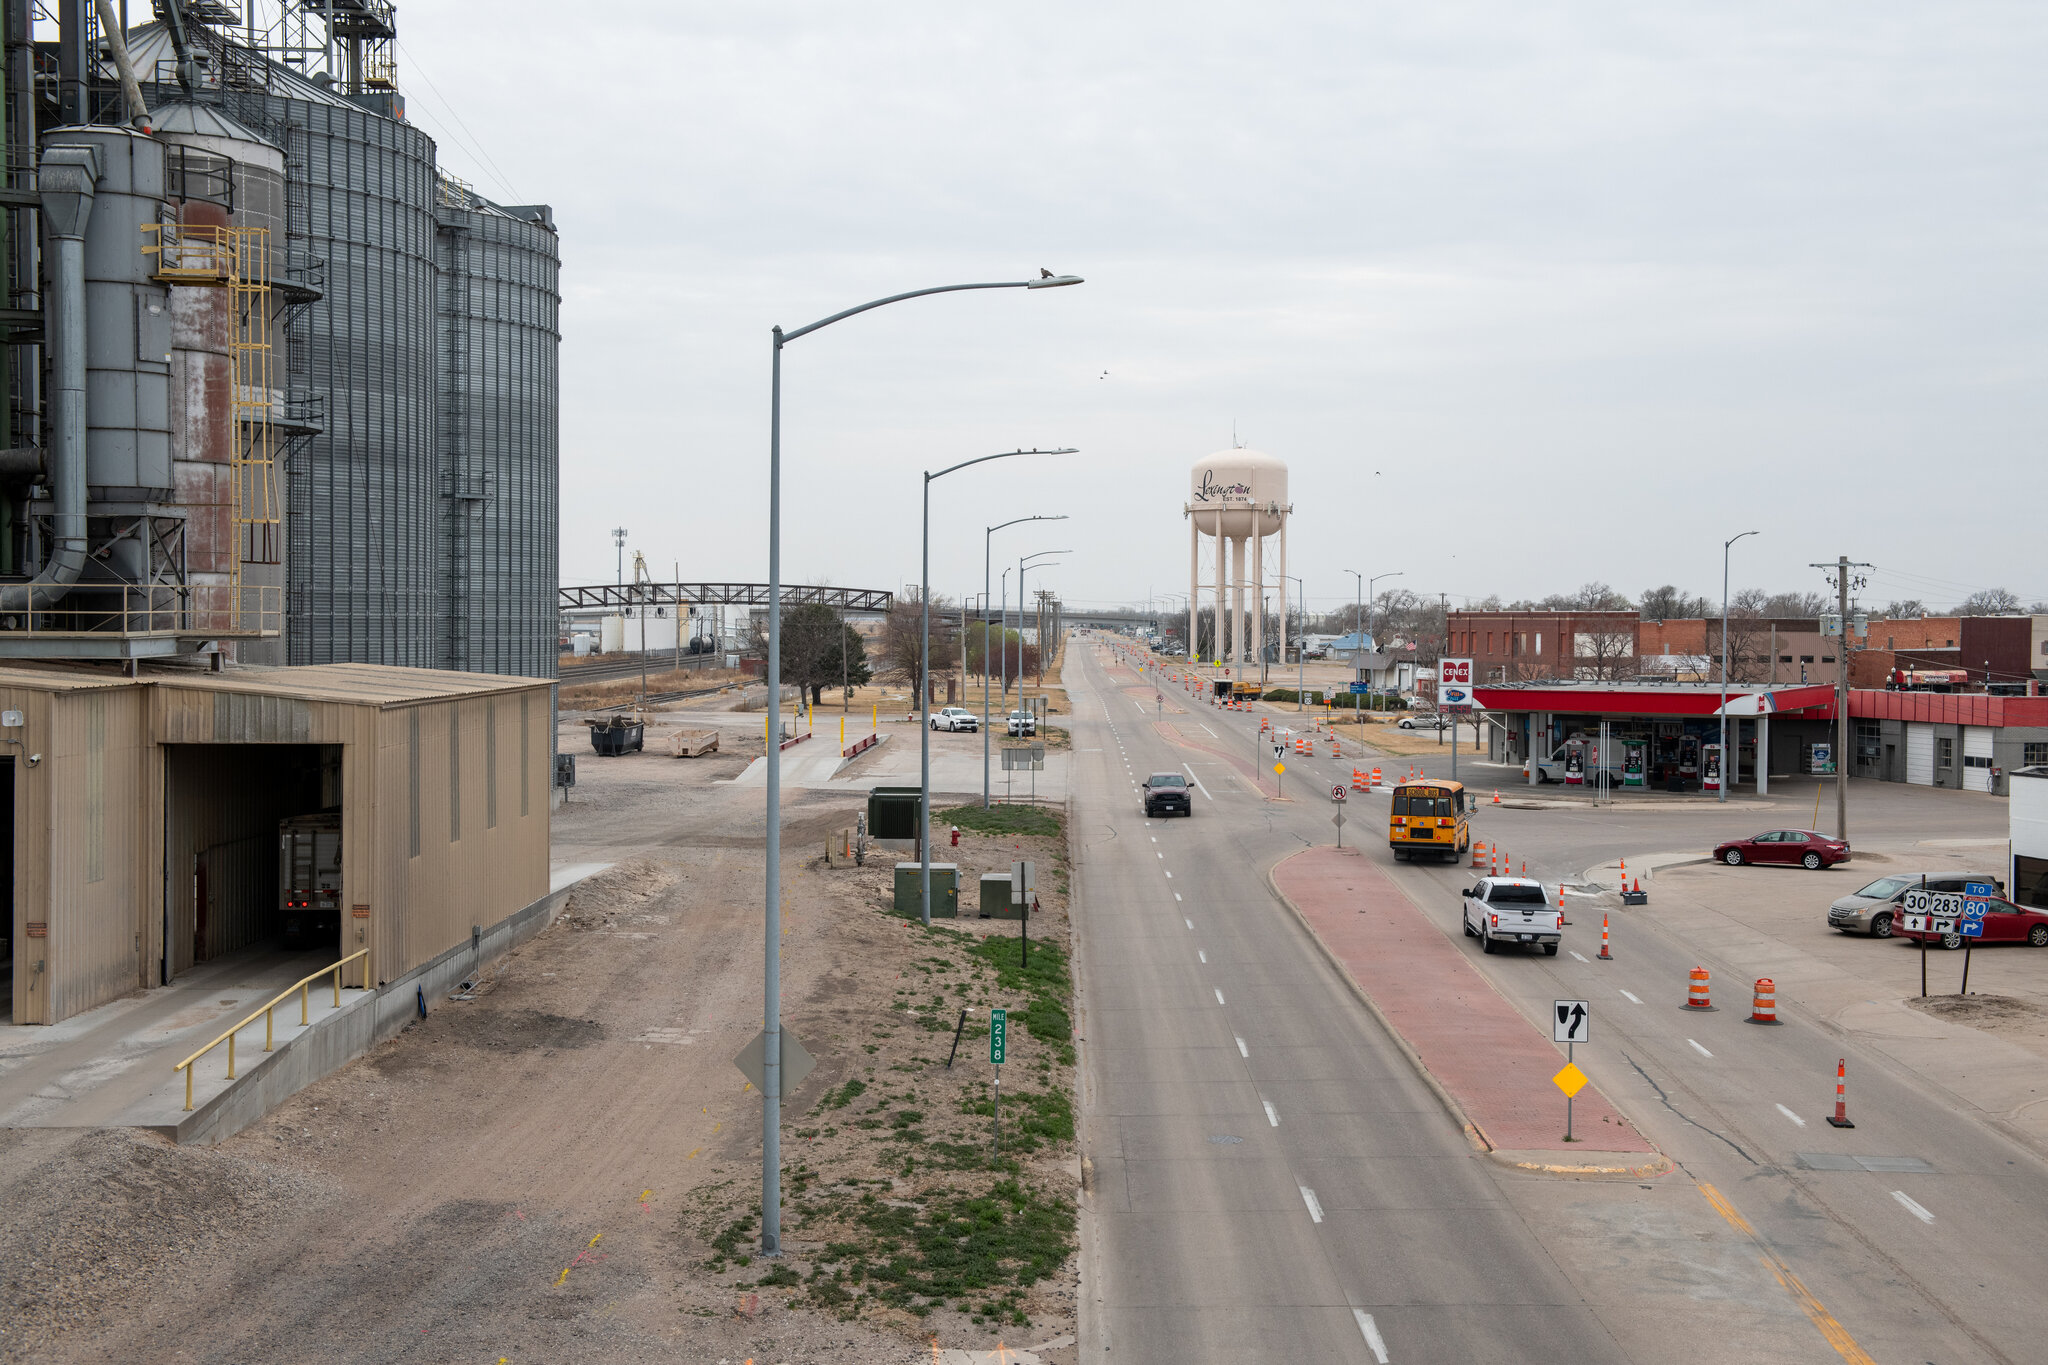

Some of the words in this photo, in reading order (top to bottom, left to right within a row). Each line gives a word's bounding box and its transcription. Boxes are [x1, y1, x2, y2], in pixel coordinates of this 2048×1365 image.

[1194, 469, 1250, 501] Lexington
[1444, 668, 1469, 676] CENEX
[1408, 788, 1426, 797] SCHOOL
[1427, 788, 1438, 797] BUS
[1972, 885, 1985, 894] TO
[1907, 895, 1927, 910] 30
[1933, 898, 1959, 913] 283
[1965, 901, 1986, 916] 80
[993, 1013, 1004, 1021] MILE
